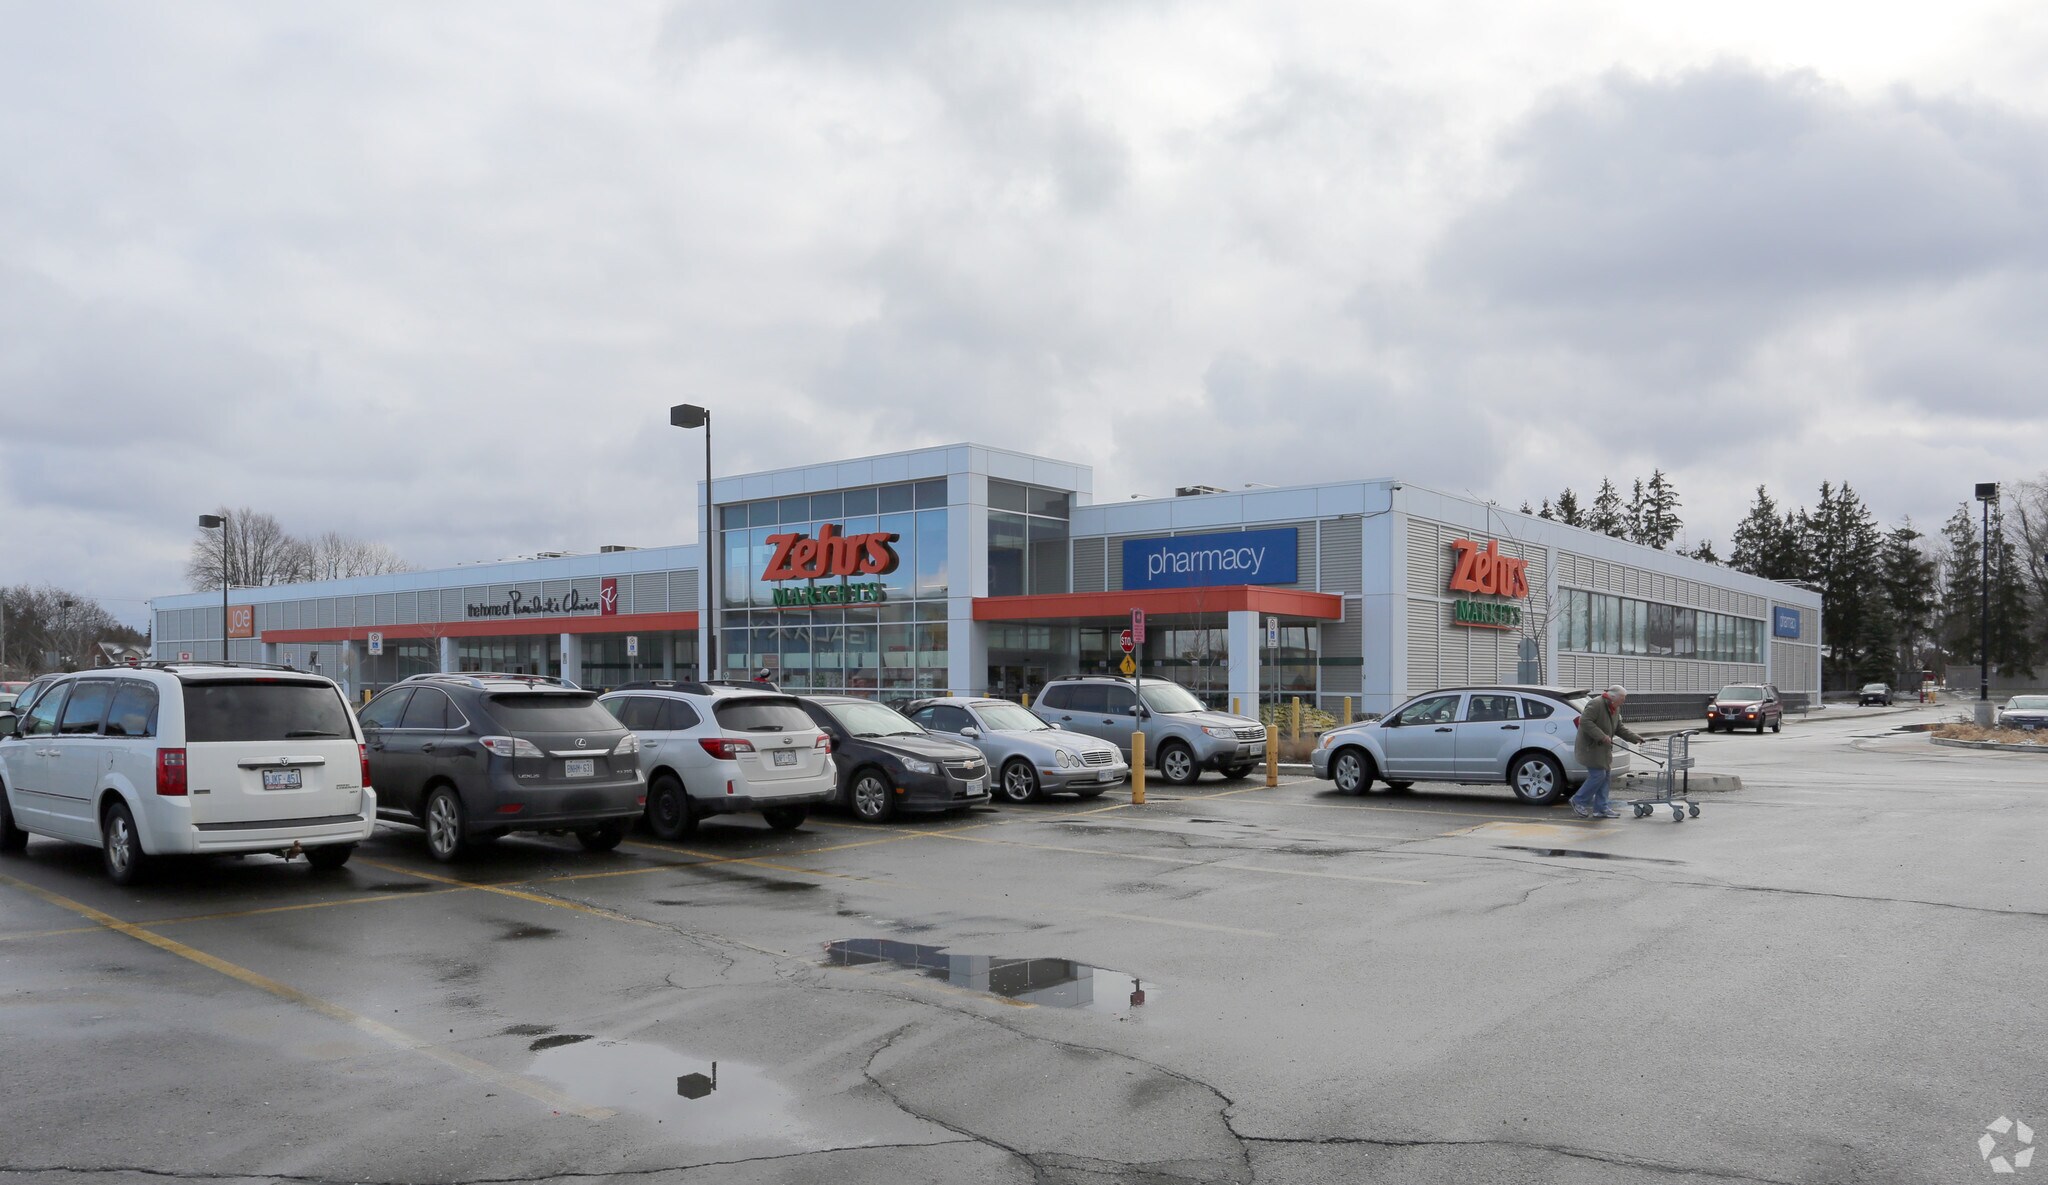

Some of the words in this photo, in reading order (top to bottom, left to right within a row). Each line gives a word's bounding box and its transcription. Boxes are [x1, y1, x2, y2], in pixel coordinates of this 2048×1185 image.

[761, 523, 893, 582] Zehrs
[1148, 546, 1266, 581] pharmacy
[1450, 538, 1529, 599] Zehrs
[467, 603, 480, 617] the
[480, 602, 501, 617] home
[501, 600, 511, 616] of
[562, 588, 600, 613] Choice
[772, 582, 881, 606] MARKETS
[1455, 599, 1522, 626] MARKETS
[1121, 636, 1133, 646] STO
